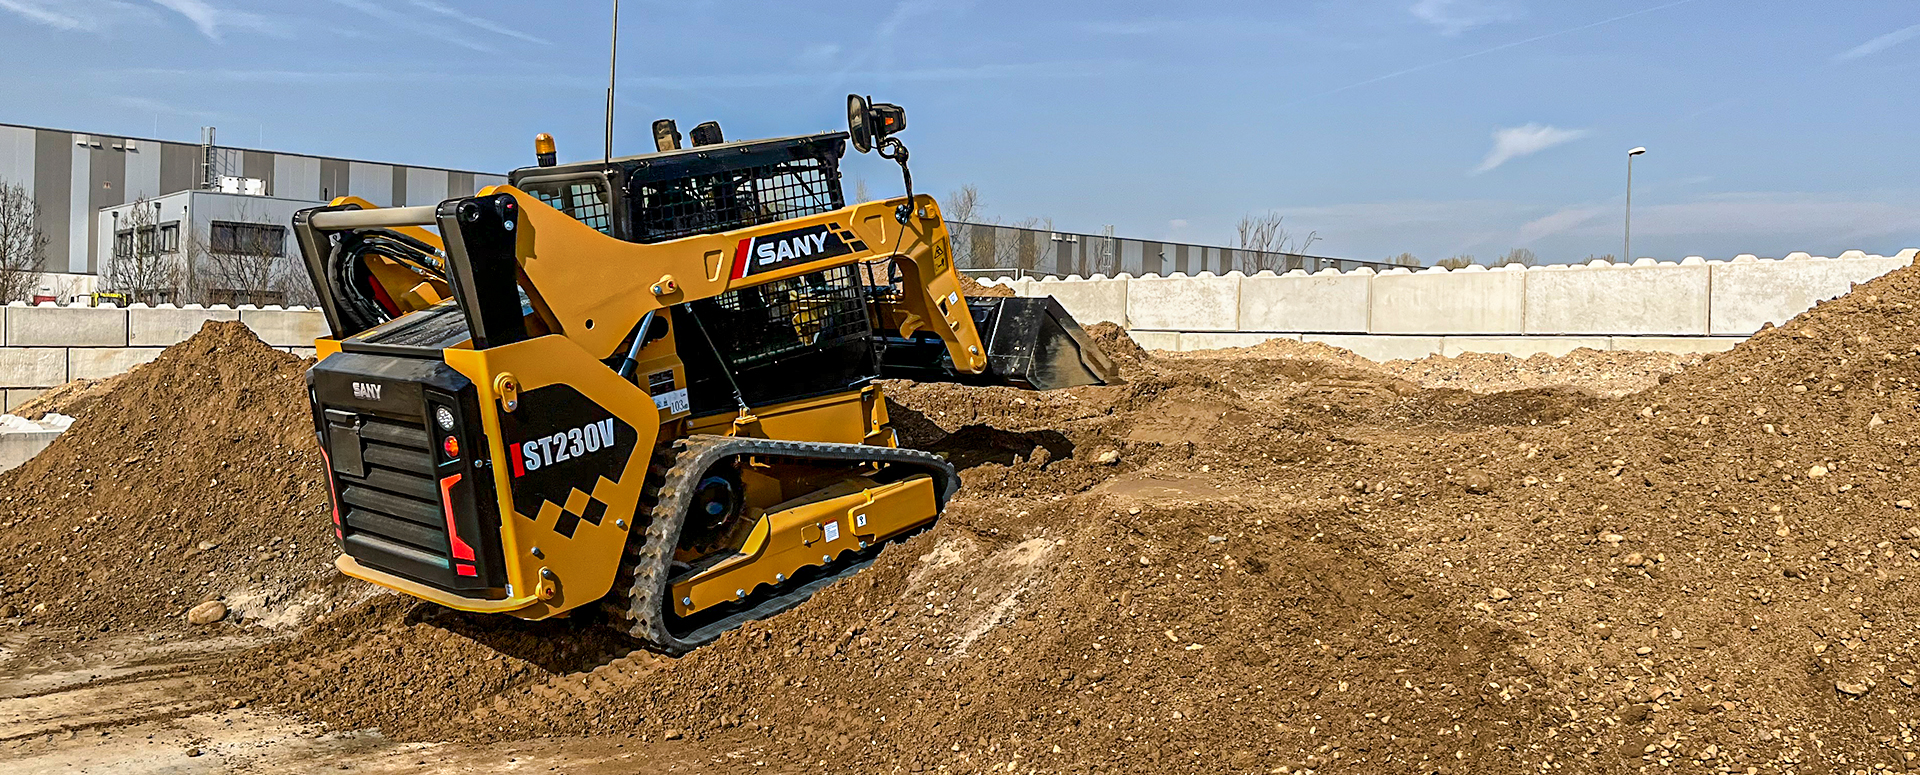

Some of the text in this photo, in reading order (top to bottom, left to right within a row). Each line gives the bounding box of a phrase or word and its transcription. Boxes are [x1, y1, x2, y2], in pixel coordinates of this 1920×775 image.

[757, 231, 828, 266] SANY
[352, 382, 382, 400] SANY
[523, 418, 614, 471] ST230V
